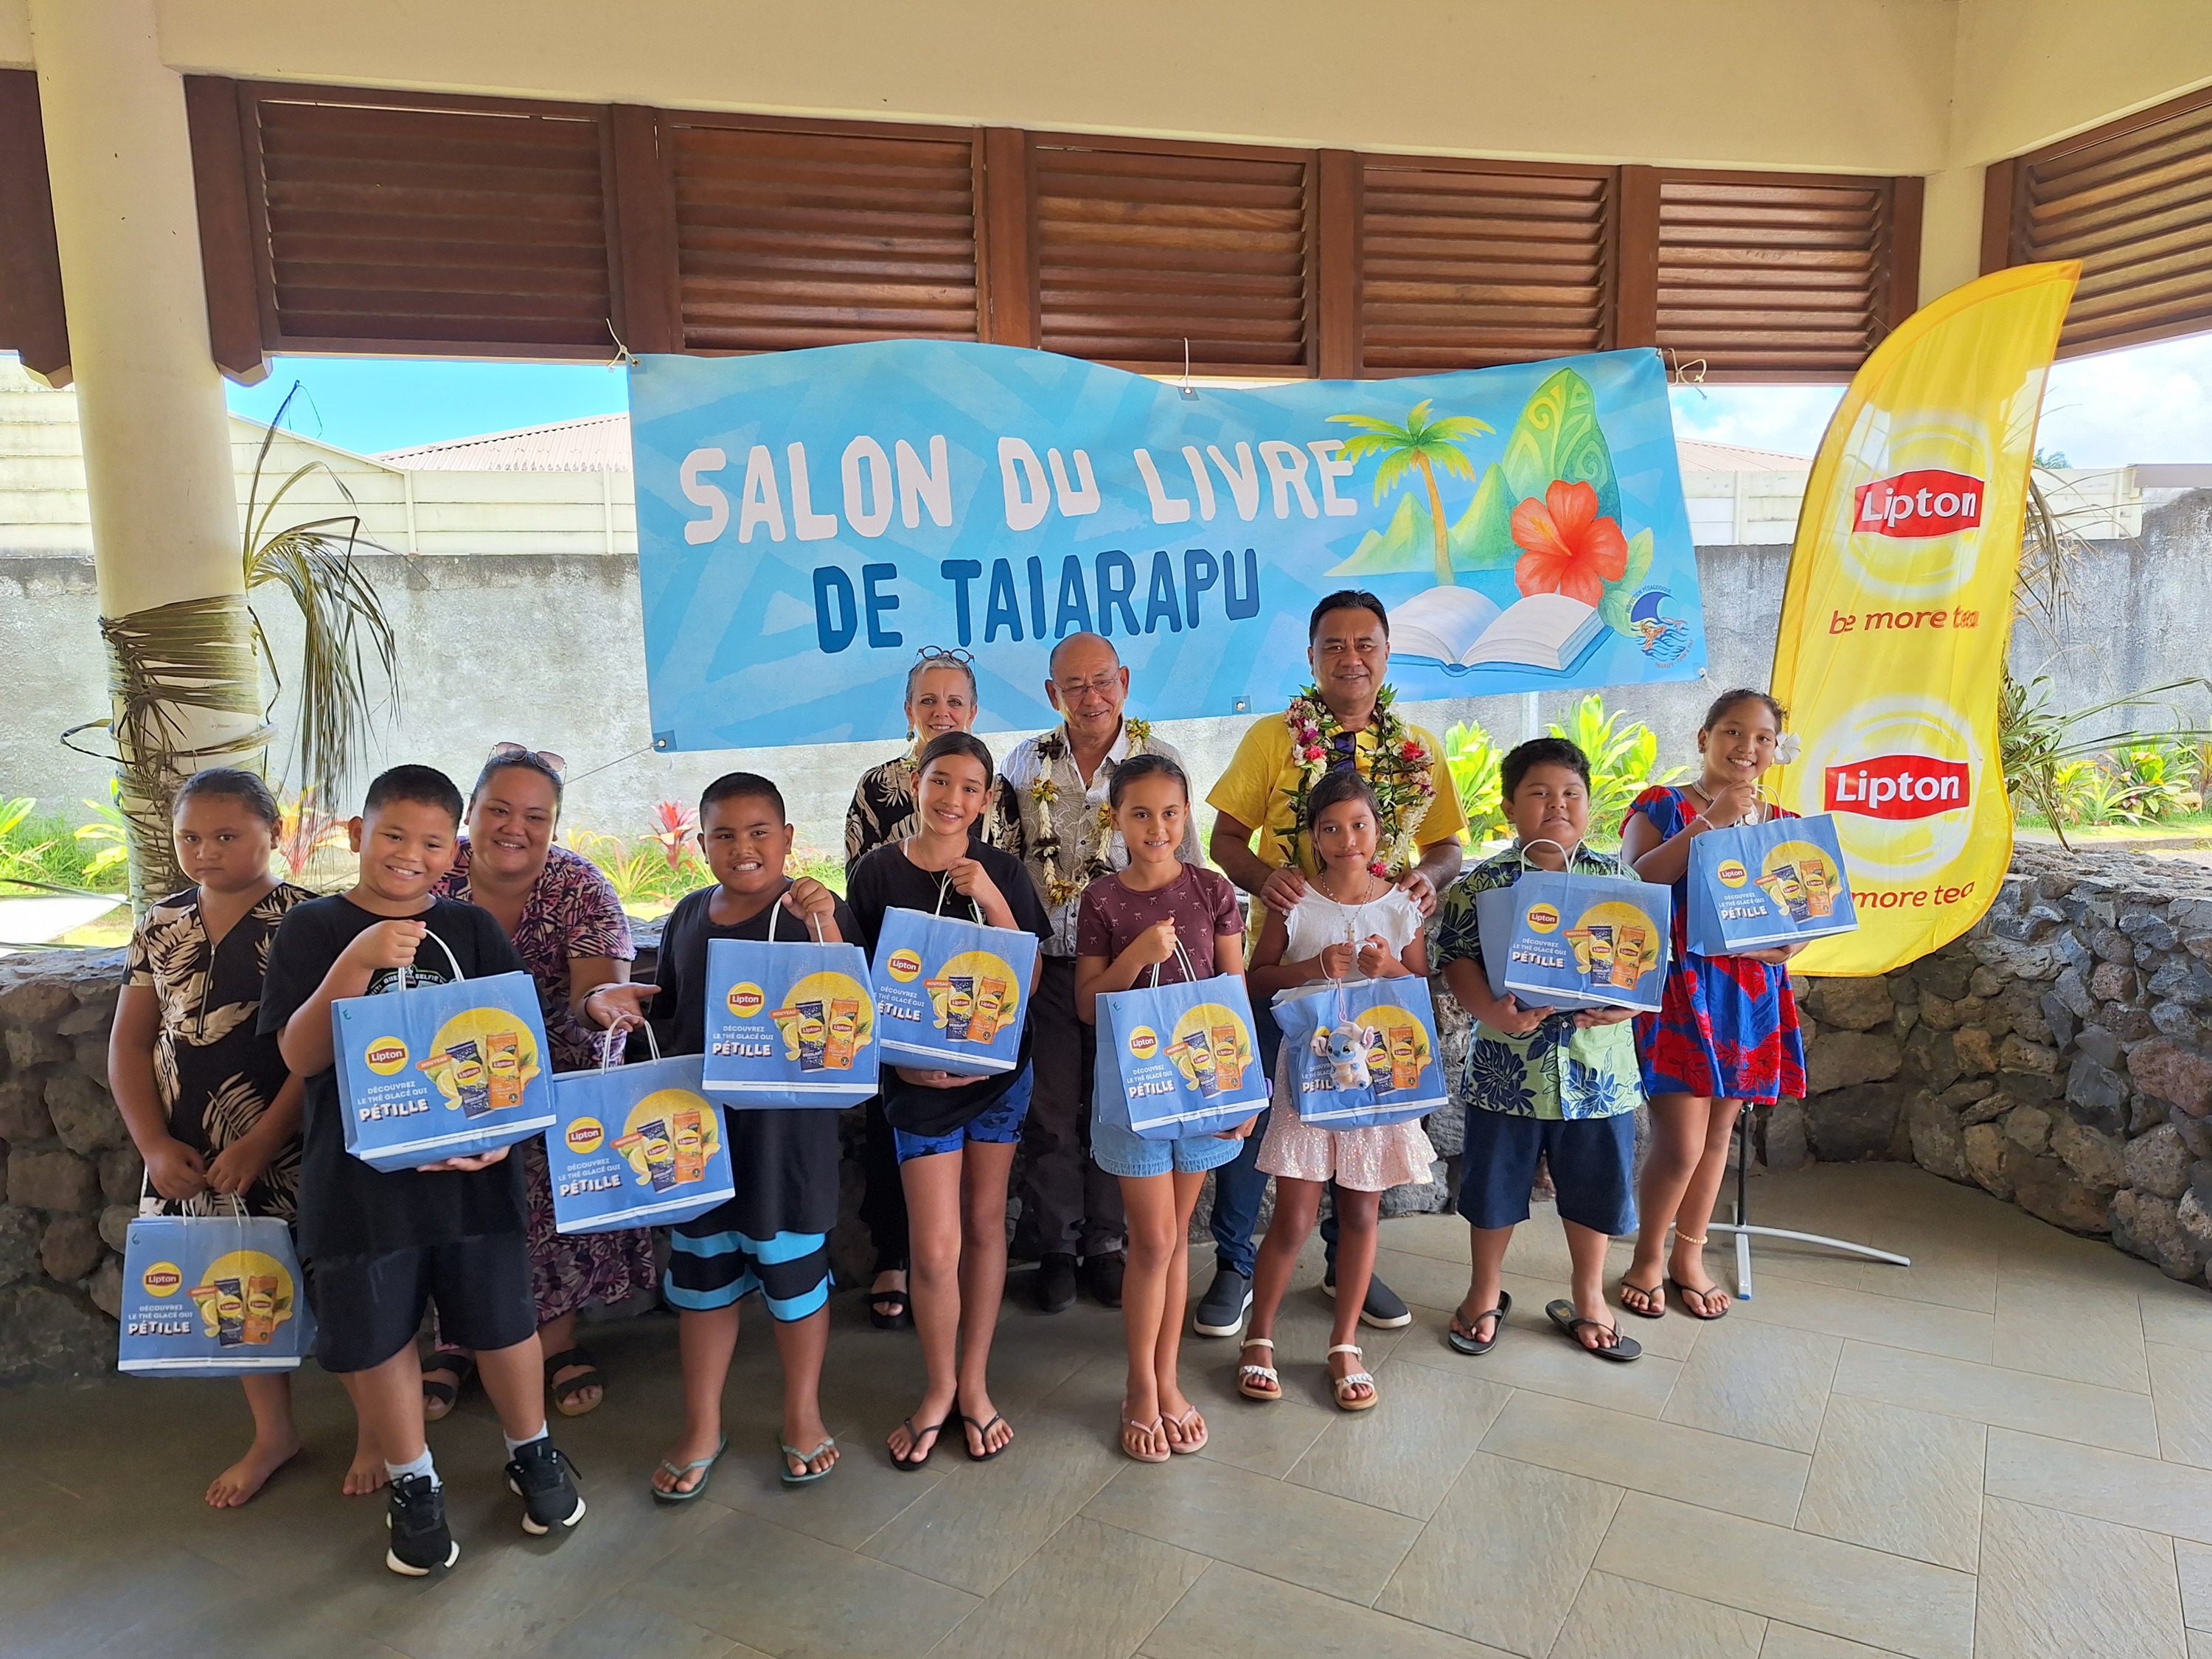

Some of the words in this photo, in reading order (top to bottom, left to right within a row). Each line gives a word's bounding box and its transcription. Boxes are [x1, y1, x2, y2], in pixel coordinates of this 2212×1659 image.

[680, 434, 952, 545] SALON
[1133, 439, 1357, 524] LIVRE
[1862, 487, 1976, 527] Lipton
[813, 563, 903, 654] DE
[941, 549, 1260, 647] TAIARAPU
[1829, 610, 1857, 635] be
[1864, 609, 1947, 631] more
[1836, 770, 1959, 809] Lipton
[1722, 870, 1743, 878] Lipton
[1851, 891, 1927, 908] more
[1934, 881, 1975, 905] tea
[1531, 914, 1555, 922] Lipton
[1721, 905, 1769, 920] PÉTILLE
[1522, 938, 1559, 947] DÉCOUVREZ
[892, 960, 917, 970] Lipton
[1512, 950, 1565, 969] PÉTILLE
[880, 986, 918, 998] DÉCOUVREZ
[732, 995, 759, 1004] Lipton
[891, 996, 912, 1005] GLACÉ
[877, 1000, 922, 1022] ÉTILLE
[712, 1040, 772, 1058] PÉTILLE
[1133, 1038, 1154, 1048] Lipton
[371, 1051, 403, 1062] Lipton
[459, 1068, 479, 1078] Lipton
[1133, 1064, 1164, 1075] DÉCOUVREZ
[1146, 1071, 1162, 1079] GLACÉ
[367, 1081, 416, 1094] DÉCOUVREZ
[1128, 1079, 1175, 1099] PÉTILLE
[1302, 1079, 1333, 1093] PÉTIL
[367, 1095, 383, 1103] THÉ
[384, 1089, 411, 1100] GLACÉ
[412, 1088, 428, 1096] QUI
[359, 1099, 430, 1121] PÉTILLE
[571, 1130, 599, 1141] Lipton
[567, 1158, 611, 1172] DÉCOUVREZ
[568, 1172, 581, 1180] THÉ
[582, 1166, 606, 1176] GLACÉ
[560, 1174, 622, 1197] PÉTILLE
[148, 1276, 176, 1284] Lipton
[153, 1311, 178, 1319] GLACÉ
[128, 1320, 191, 1335] PÉTILLE
